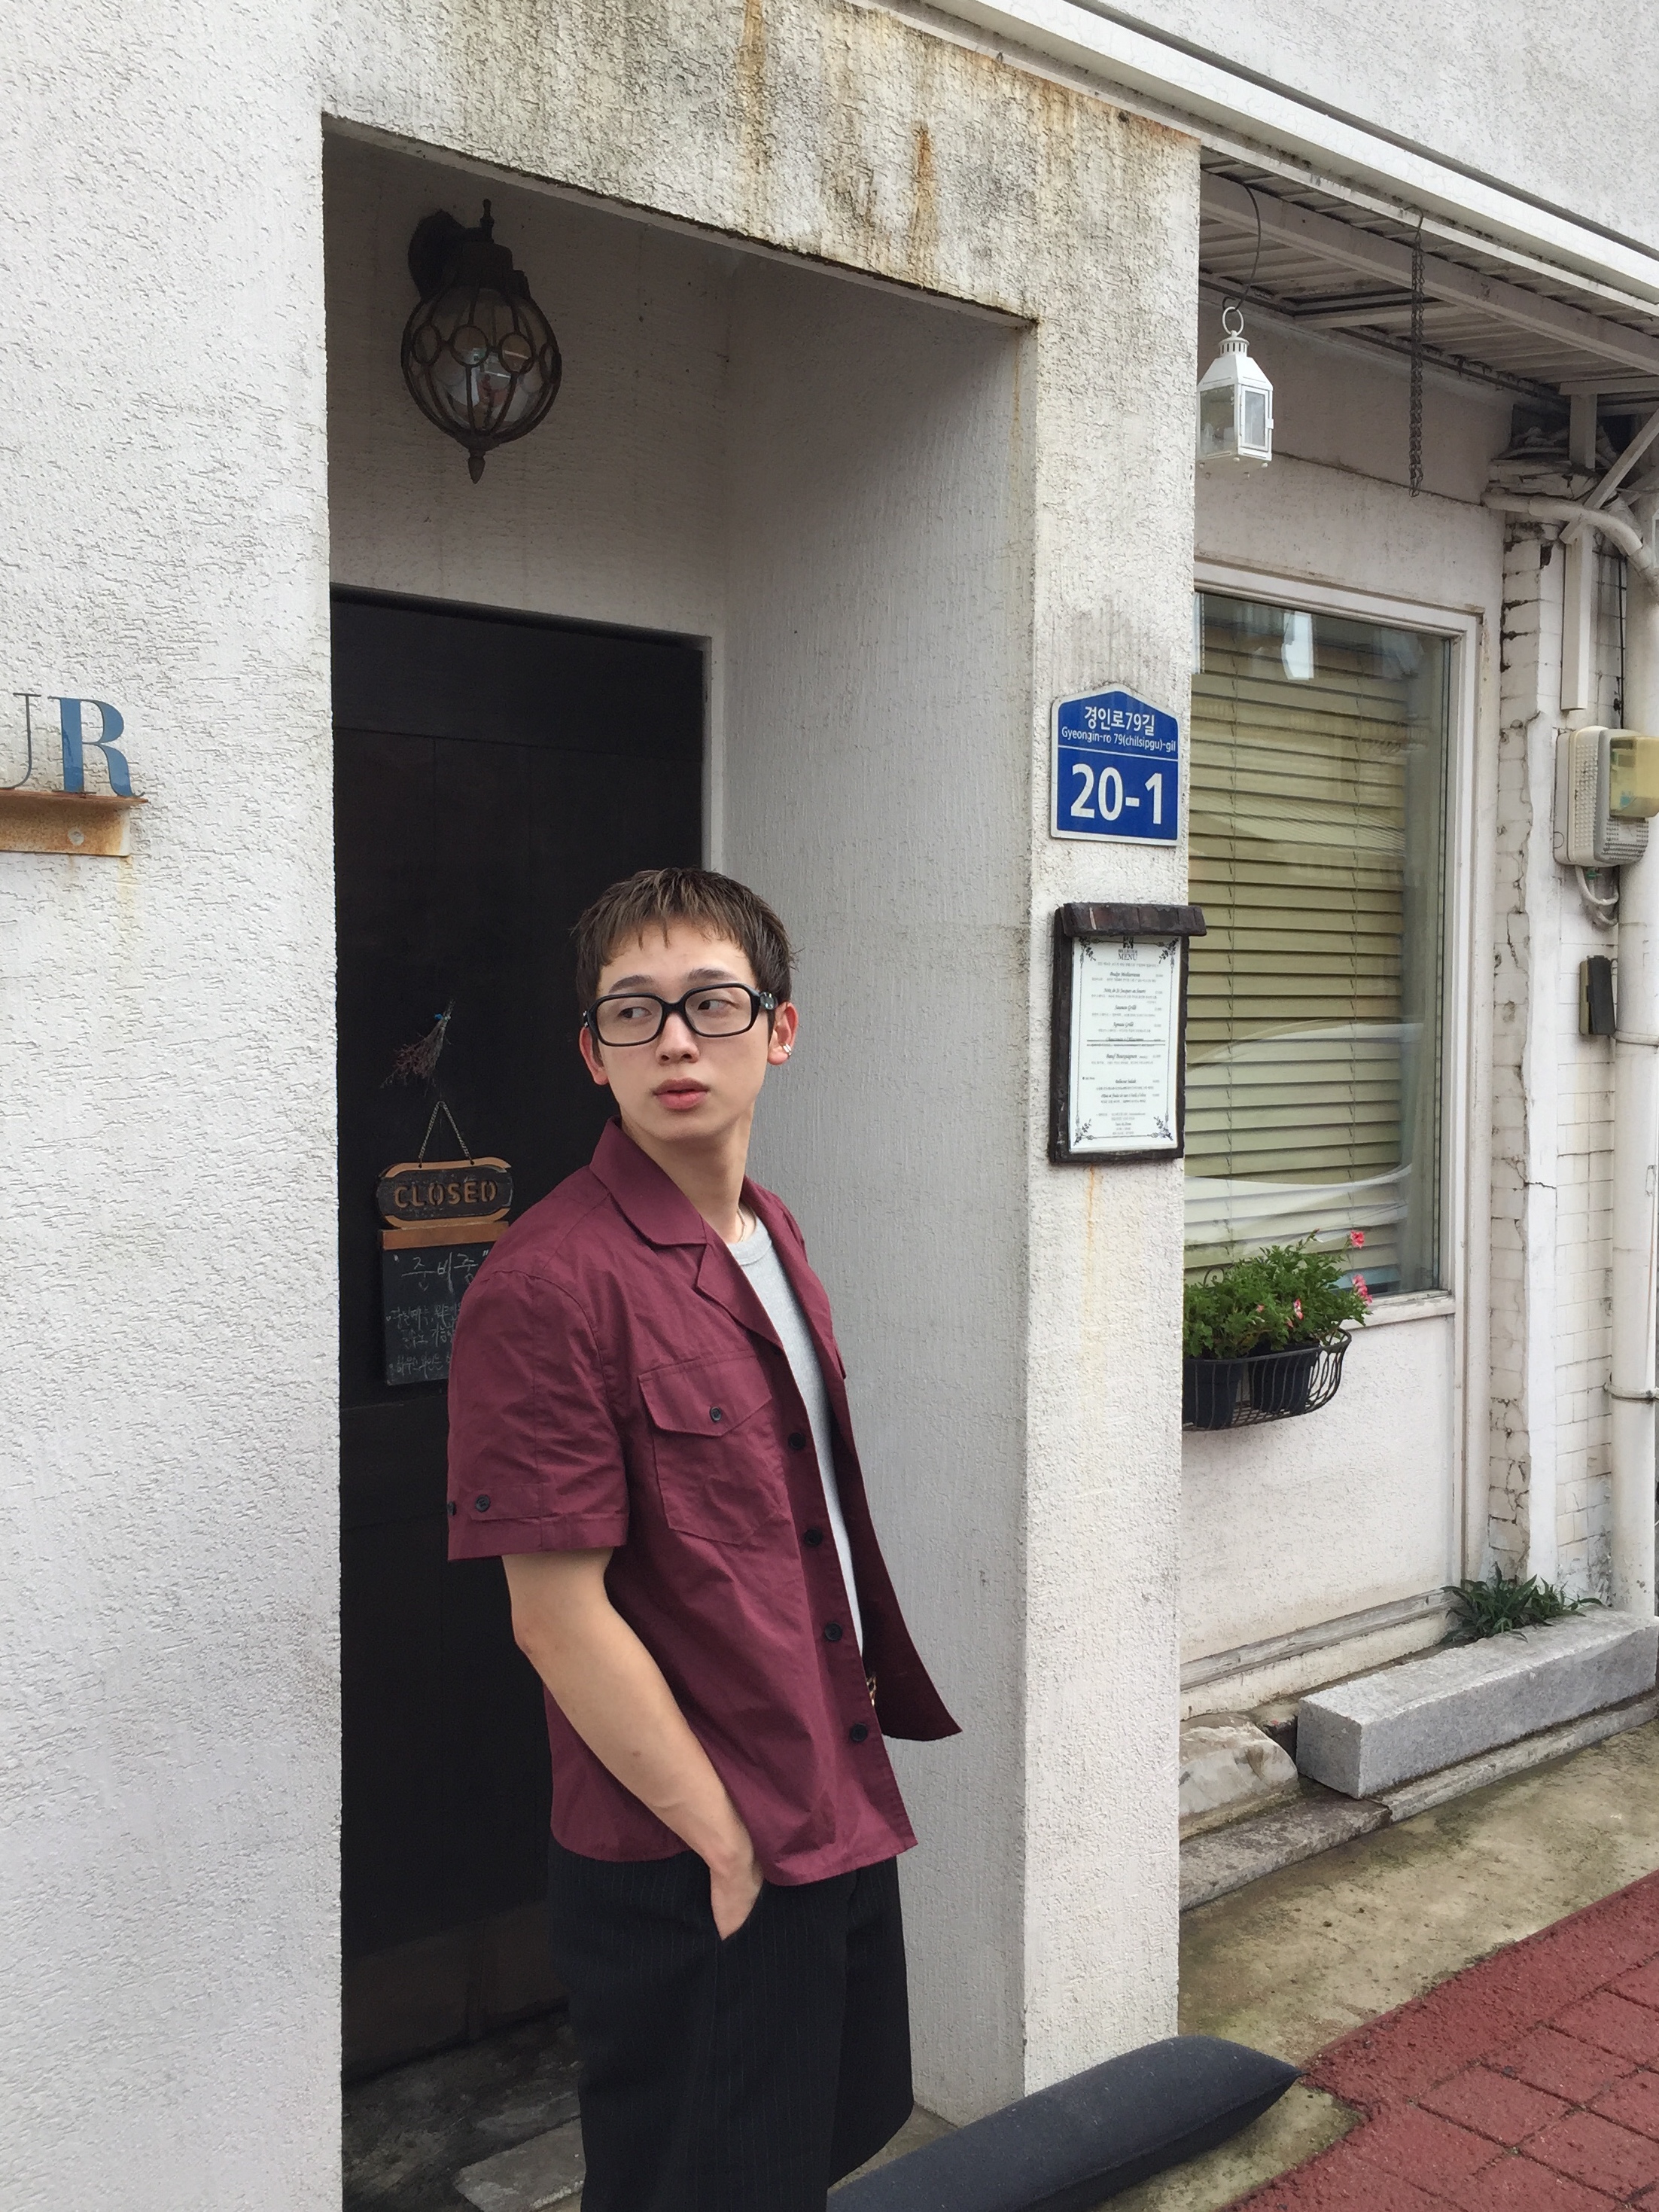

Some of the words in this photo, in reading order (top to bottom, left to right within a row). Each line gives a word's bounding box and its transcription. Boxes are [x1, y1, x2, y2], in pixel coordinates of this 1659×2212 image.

[1084, 706, 1155, 736] 경인로79길
[1061, 726, 1112, 743] Gyeongin-ro
[1113, 733, 1176, 752] 79(chilsipgu)-gil
[1070, 763, 1162, 824] 20-1
[394, 1180, 498, 1208] CLOSED
